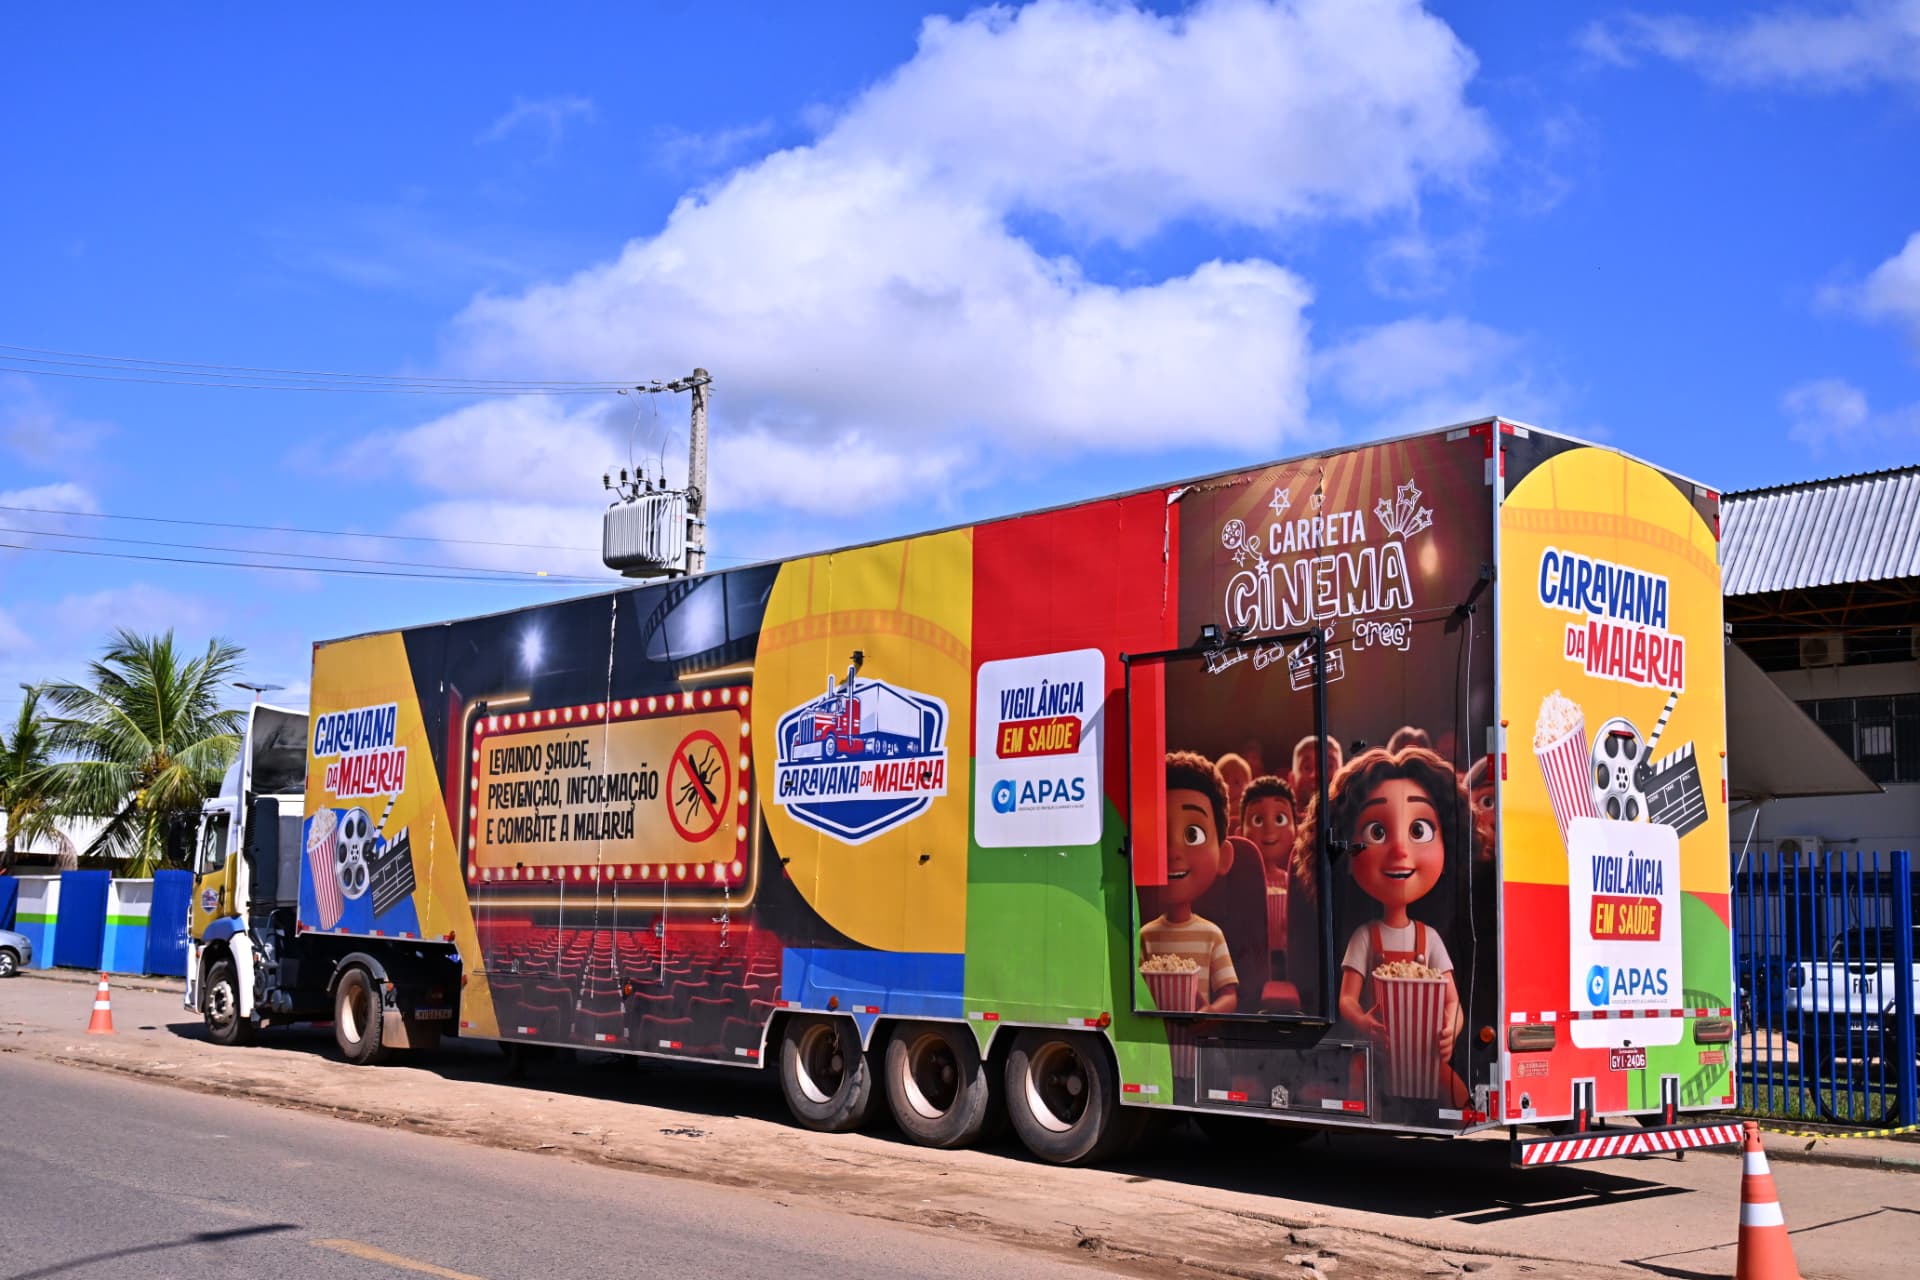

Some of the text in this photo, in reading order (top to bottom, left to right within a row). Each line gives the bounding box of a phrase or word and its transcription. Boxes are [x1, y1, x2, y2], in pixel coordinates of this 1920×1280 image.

[1268, 510, 1366, 555] CARRETA
[1225, 541, 1413, 635] CINEMA
[1540, 551, 1667, 629] CARAVANA
[1566, 621, 1683, 689] DA MALÁRIA
[1001, 679, 1083, 720] VIGILÂNCIA
[314, 706, 396, 755] CARAVANA
[1002, 718, 1074, 754] EM SAÚDE
[326, 748, 405, 796] DA MALÁRIA
[489, 733, 591, 775] LEVANDO SAÚDE,
[487, 762, 658, 814] PREVENÇÃO, INFORMAÇÃO
[779, 758, 944, 797] CARAVANA DA MALÁRIA
[1019, 777, 1085, 804] APAS
[486, 803, 634, 845] E COMBATE A MALÁRIA
[1592, 850, 1663, 895] VIGILÂNCIA
[1595, 897, 1656, 935] EM SAÚDE
[1613, 967, 1668, 996] APAS
